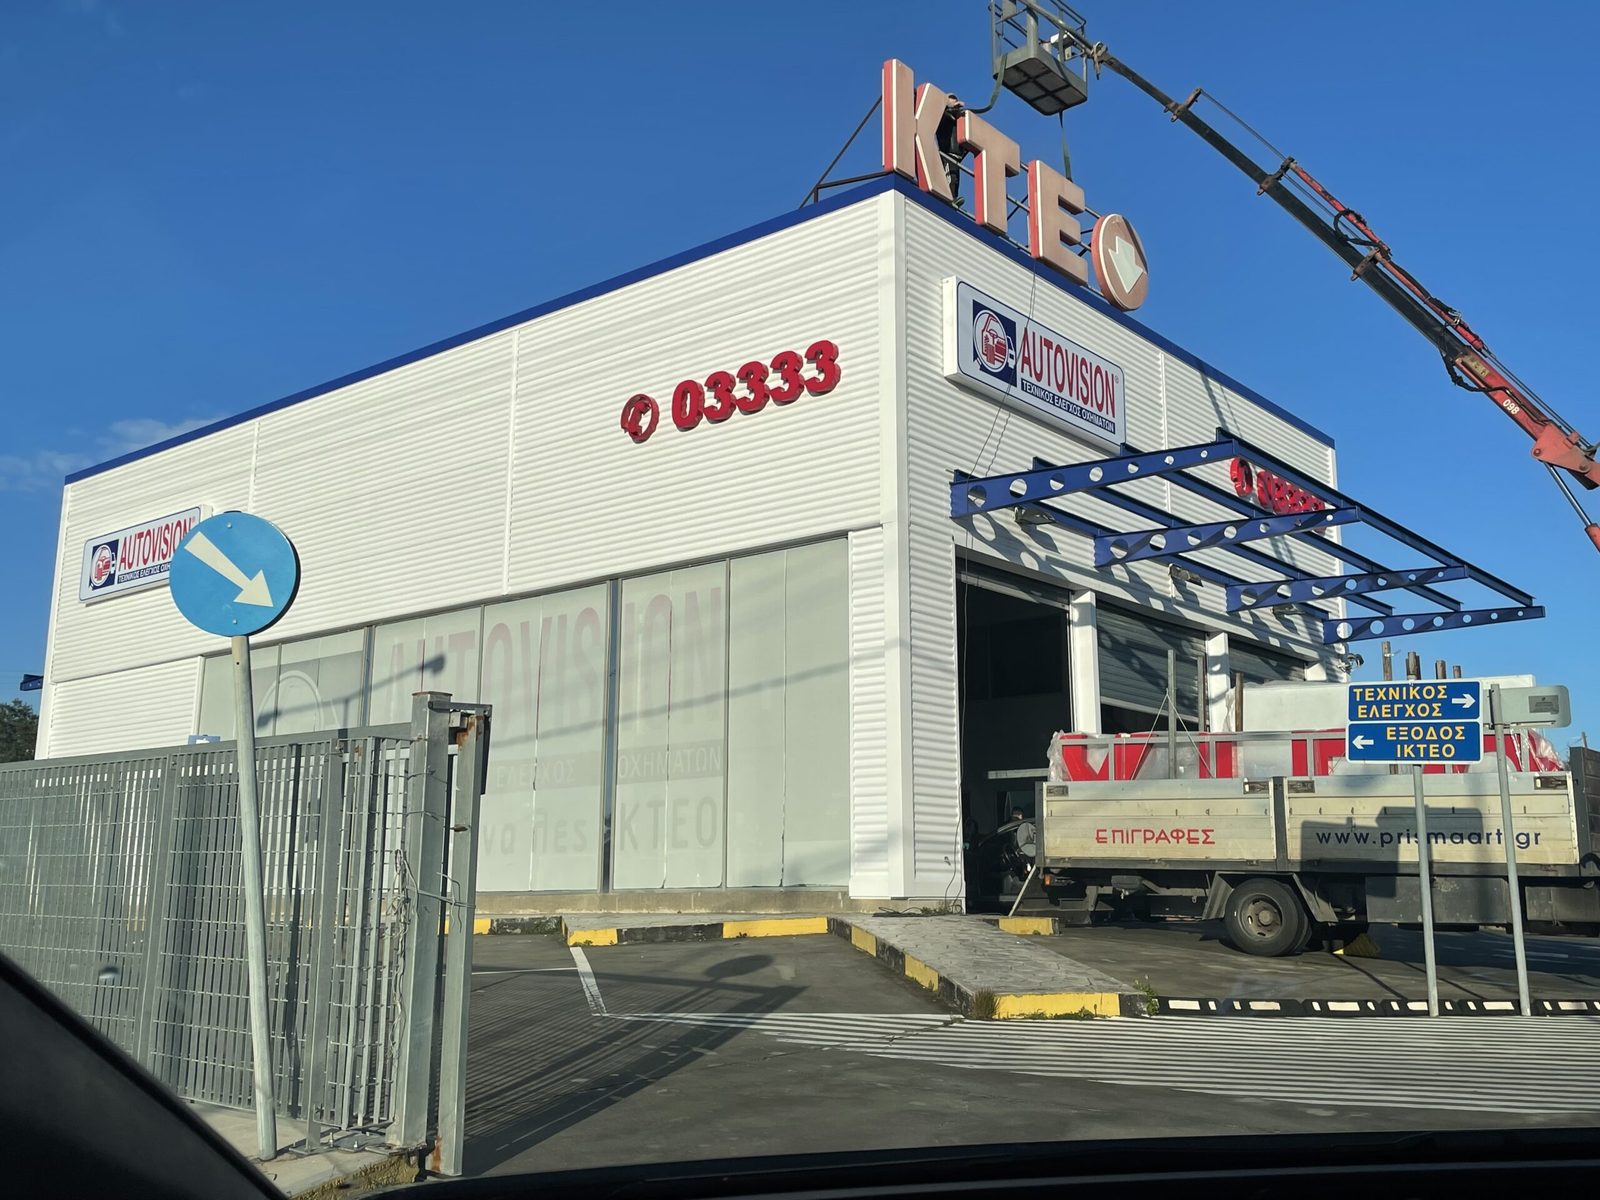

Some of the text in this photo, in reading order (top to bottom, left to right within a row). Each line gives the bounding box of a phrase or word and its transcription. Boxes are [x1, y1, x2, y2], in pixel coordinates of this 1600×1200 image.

[1020, 327, 1116, 418] AUTOVISION
[671, 339, 842, 432] 03333
[1022, 380, 1115, 434] ΤΕΧΝΙΚΟΣ ΕΛΕΓΧΟΣ ΟΧΗΜΑΤΩΝ
[1353, 685, 1448, 702] ΤΕΧΝΙΚΟΣ
[1357, 703, 1442, 718] ΕΛΕΓΧΟΣ
[1386, 726, 1466, 741] ΕΞΟΔΟΣ
[1396, 743, 1456, 758] ΙΚΤΕΟ
[1095, 828, 1216, 846] ΕΠΙΓΡΑΦΕΣ
